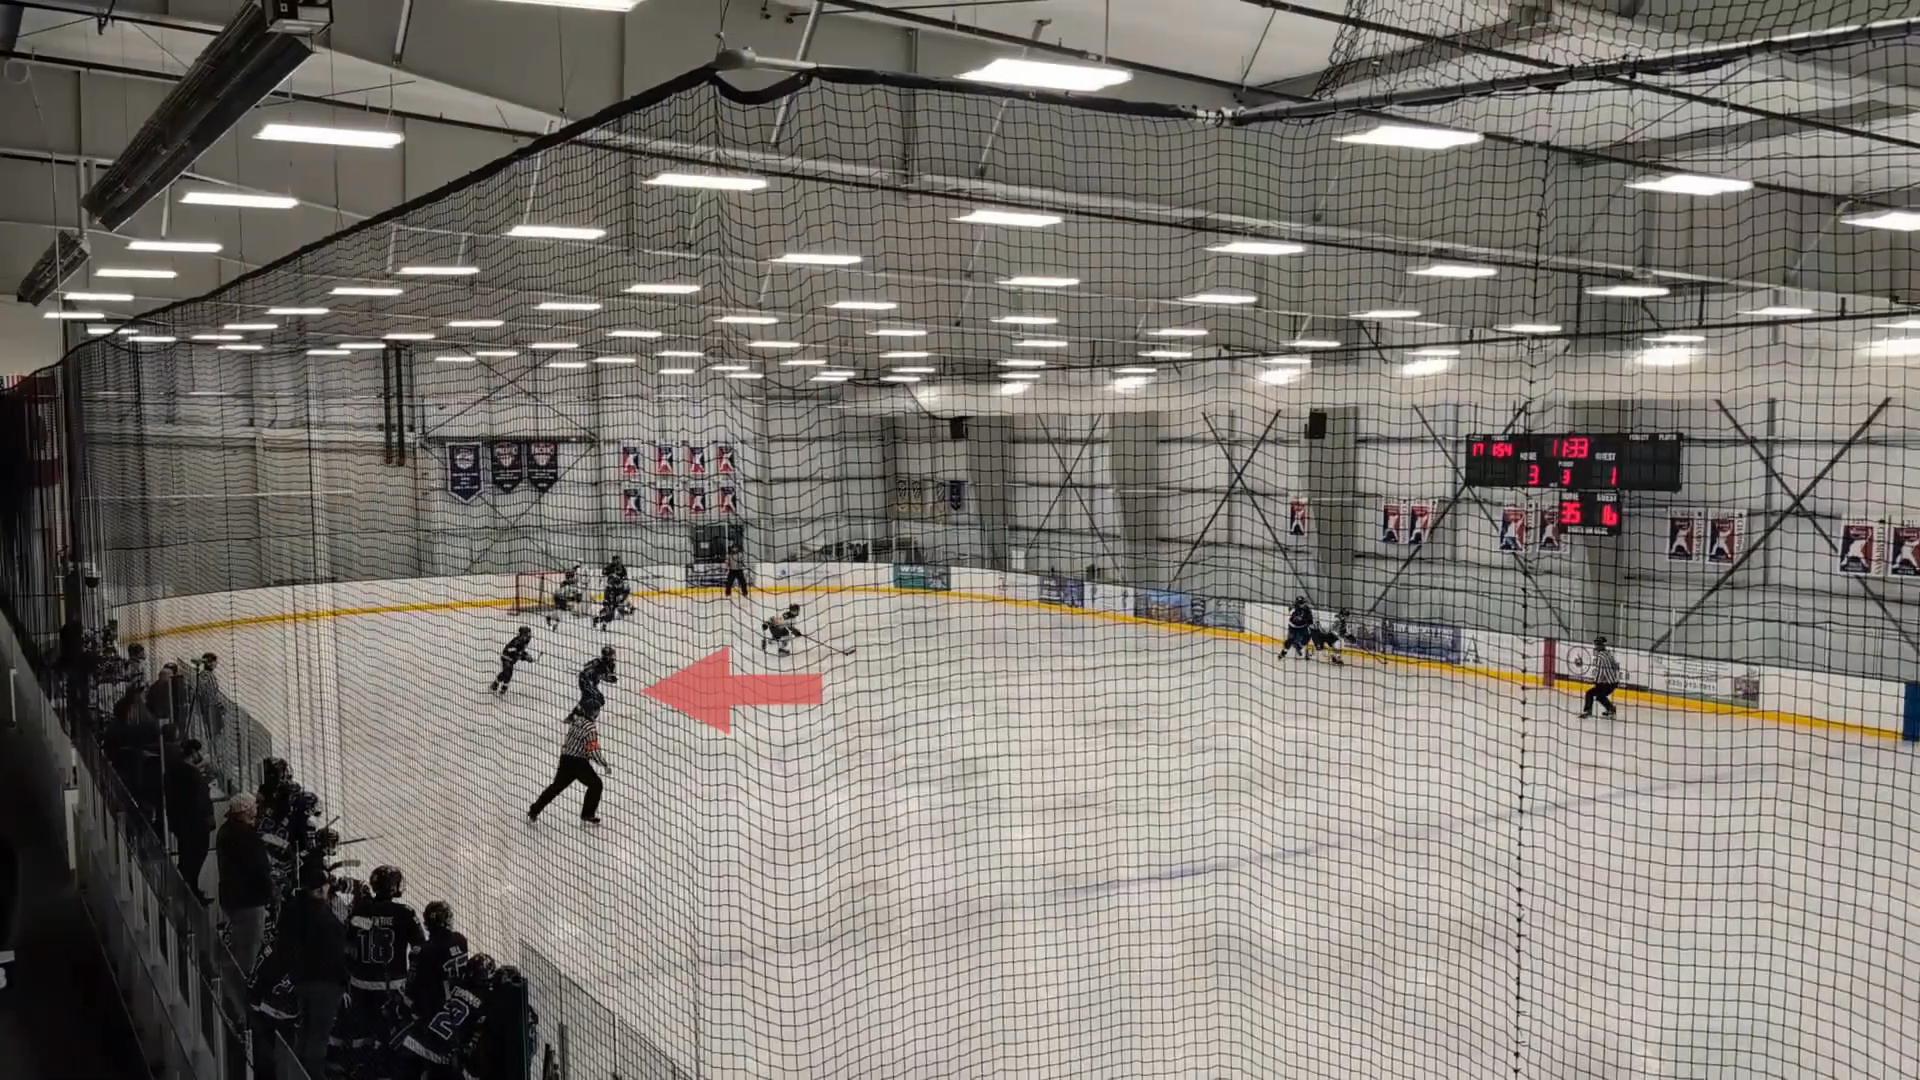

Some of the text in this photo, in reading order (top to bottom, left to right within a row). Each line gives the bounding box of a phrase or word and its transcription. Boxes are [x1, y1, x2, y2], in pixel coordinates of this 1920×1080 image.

[1528, 464, 1540, 485] 3
[1610, 466, 1617, 485] 1
[1561, 501, 1581, 524] 35
[356, 926, 396, 964] 18
